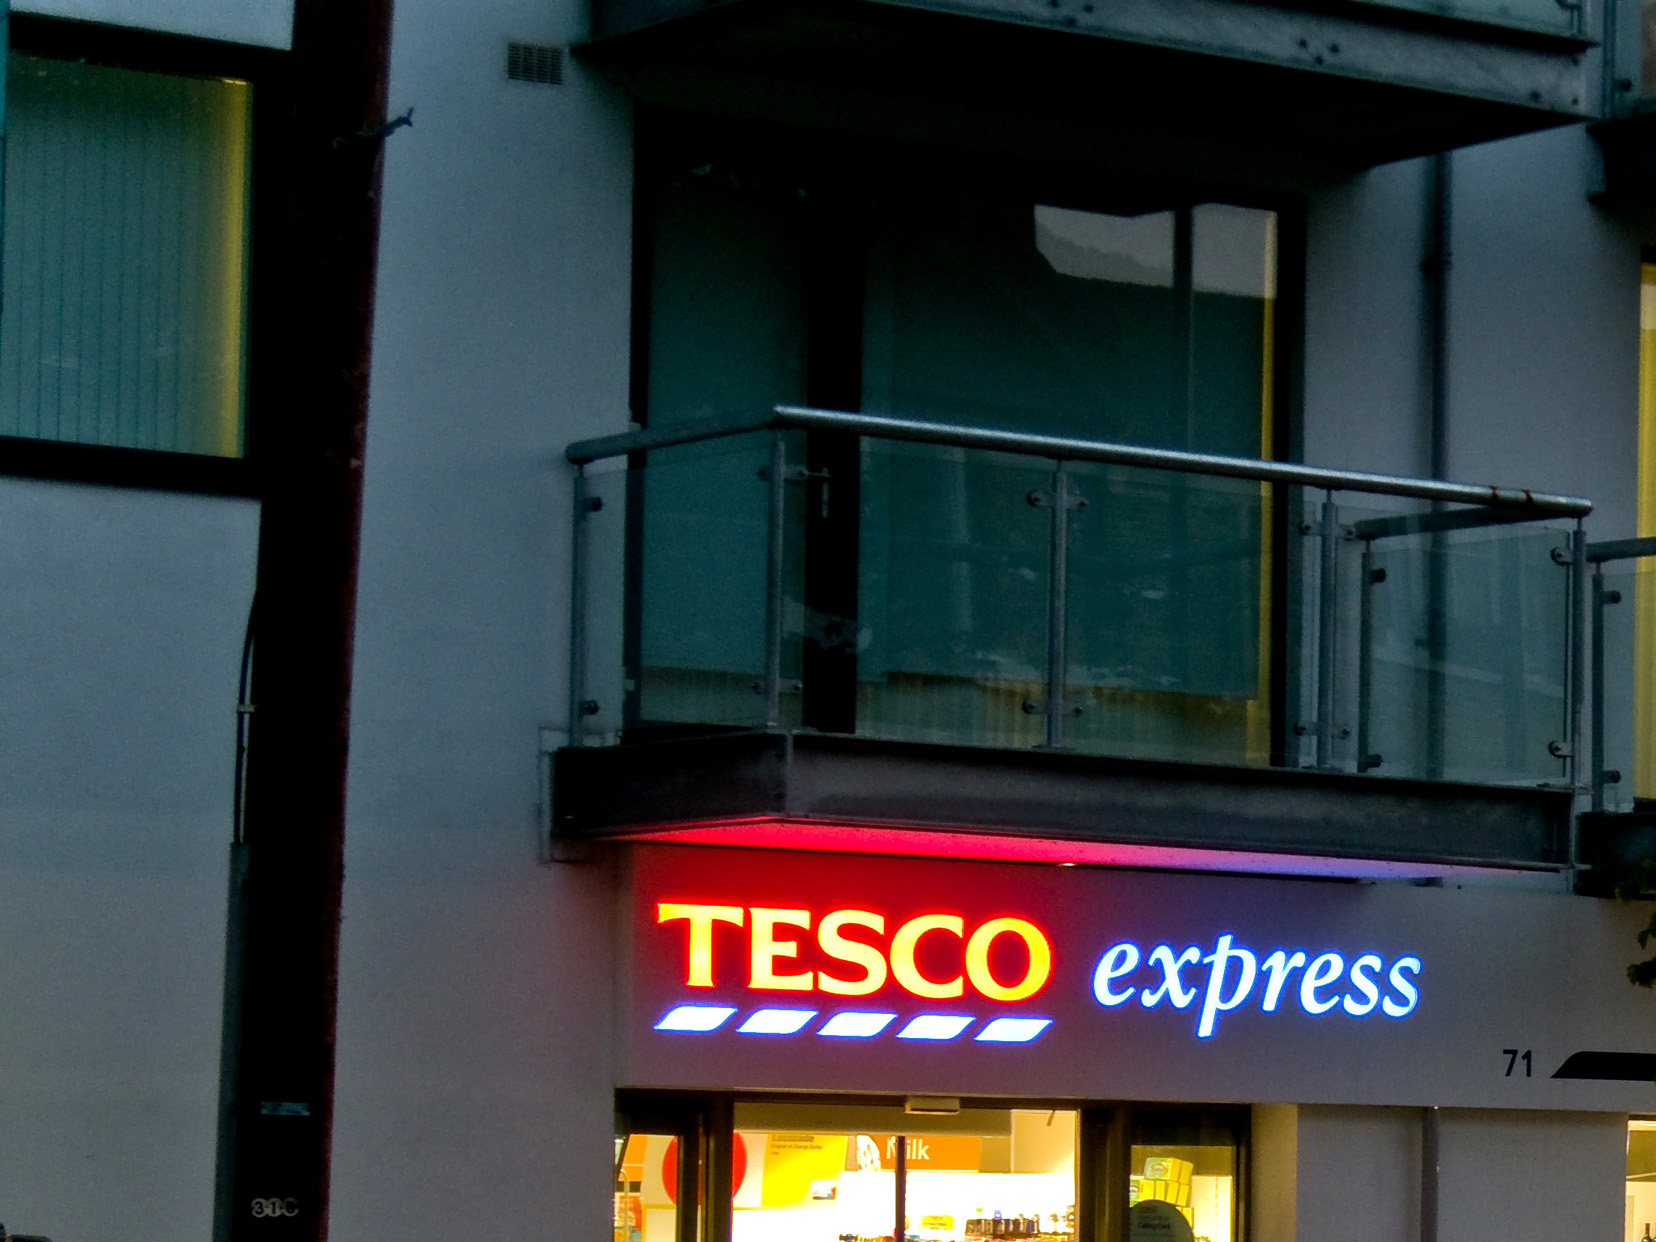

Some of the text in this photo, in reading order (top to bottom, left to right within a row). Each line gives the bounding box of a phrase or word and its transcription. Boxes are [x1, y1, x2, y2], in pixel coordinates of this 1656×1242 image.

[656, 902, 1424, 1039] TESCO express
[1503, 1049, 1532, 1078] 71
